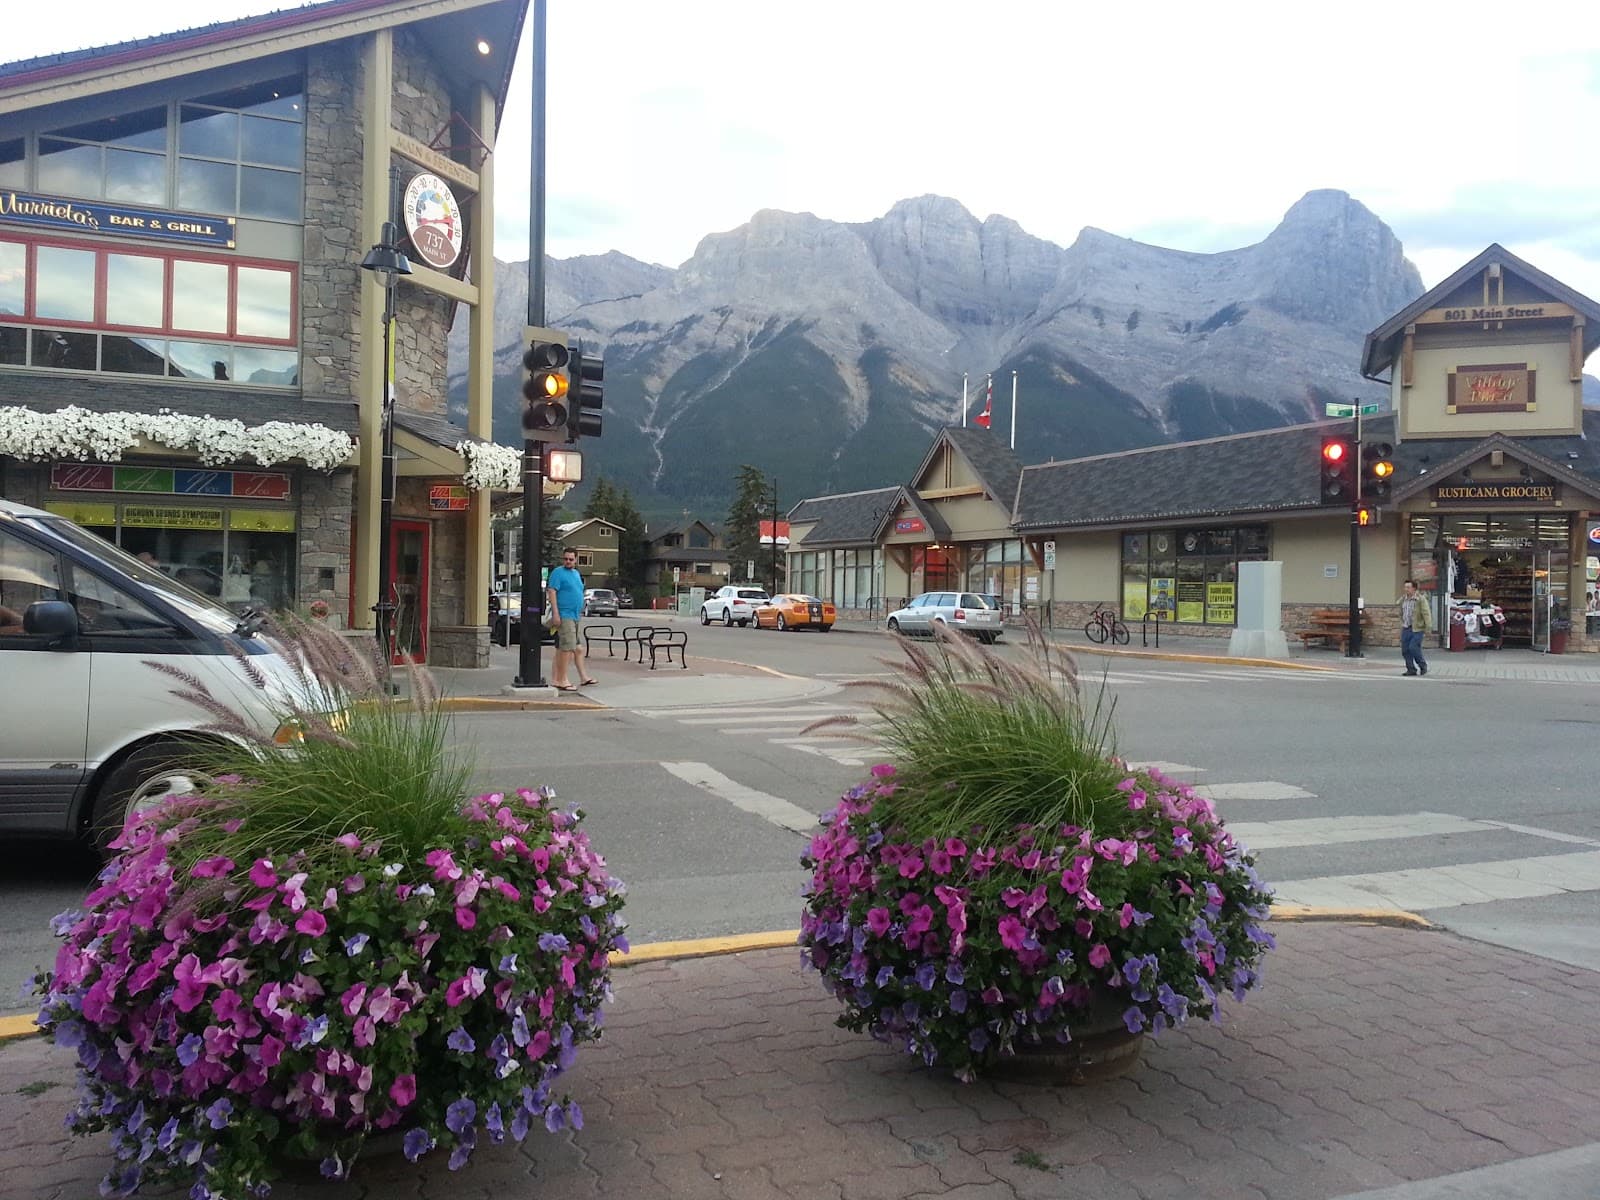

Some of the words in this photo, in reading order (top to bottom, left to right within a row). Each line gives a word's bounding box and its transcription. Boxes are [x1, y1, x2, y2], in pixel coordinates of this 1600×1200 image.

[110, 215, 145, 227] BAR
[150, 220, 162, 229] &
[166, 222, 216, 235] GRILL
[426, 231, 444, 250] 737
[423, 245, 439, 257] MAIN
[1445, 310, 1467, 321] 801
[1471, 308, 1503, 319] Main
[1507, 307, 1544, 317] Street
[1438, 487, 1499, 498] RUSTICANA
[1501, 486, 1554, 498] GROCERY
[182, 510, 221, 520] SYMPOSIUM
